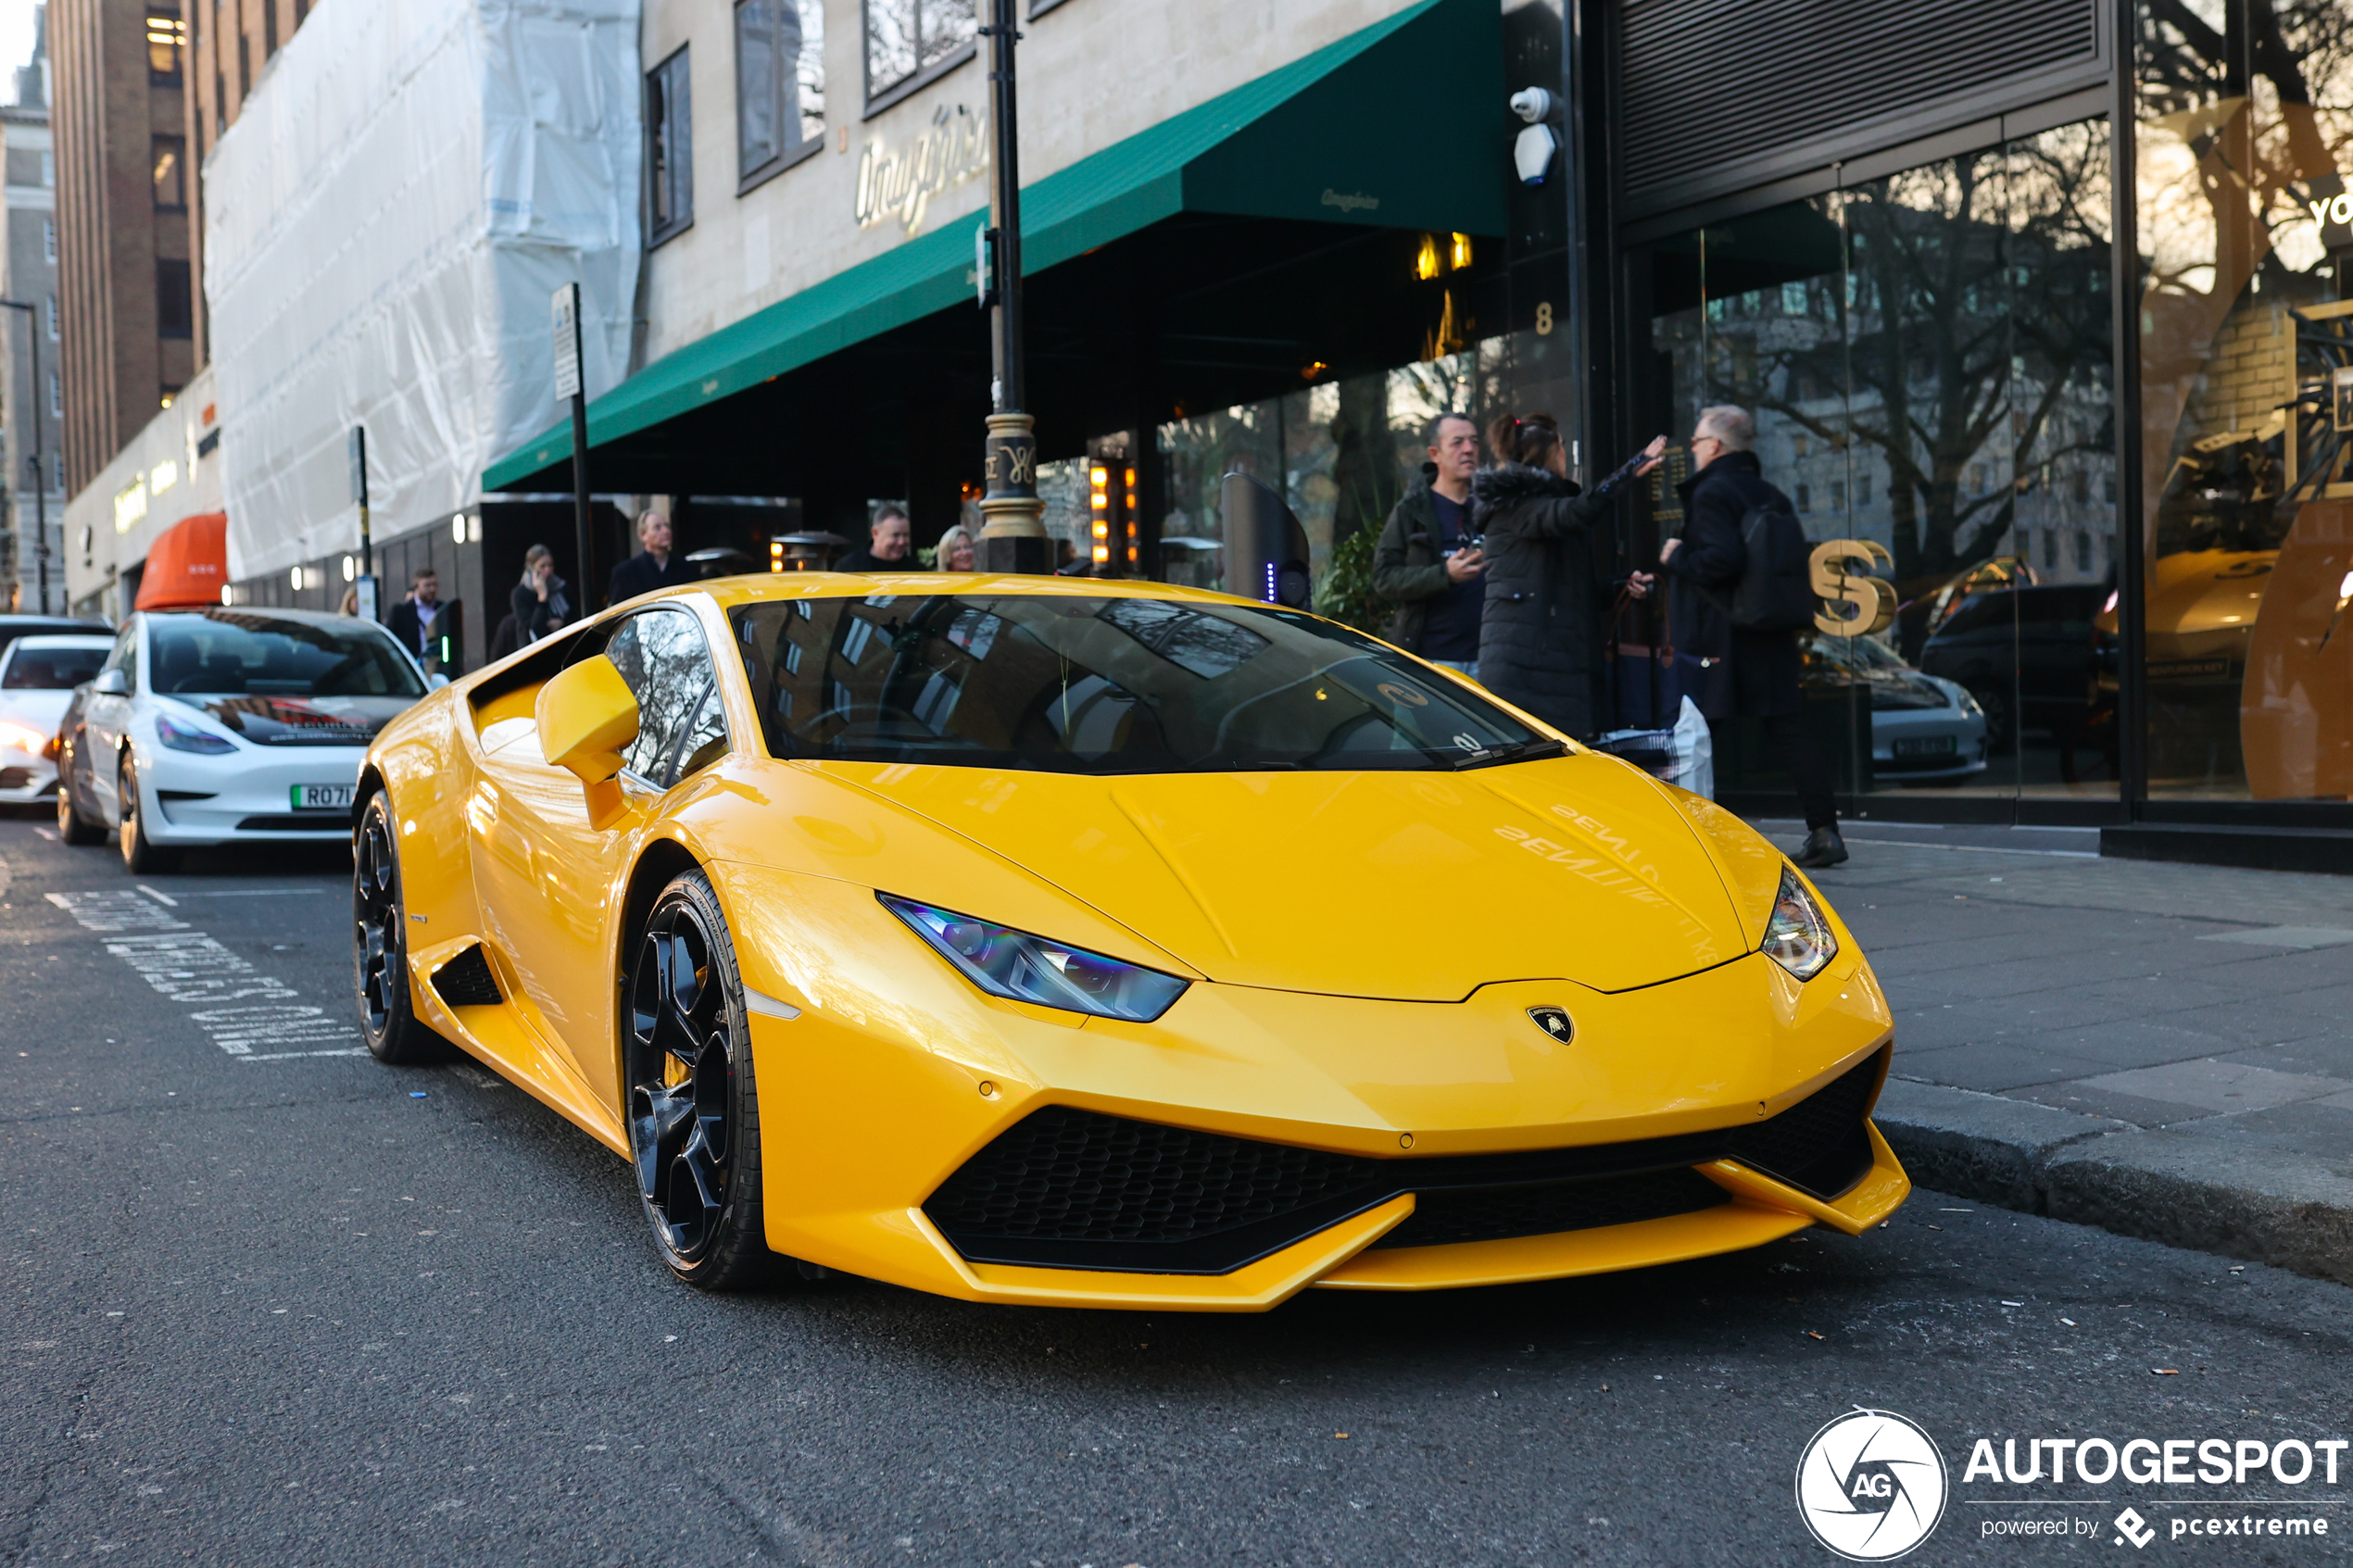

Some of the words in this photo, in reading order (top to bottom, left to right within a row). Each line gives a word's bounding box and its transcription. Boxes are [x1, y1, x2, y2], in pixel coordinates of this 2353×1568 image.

[1536, 302, 1553, 335] 8
[308, 788, 350, 805] RO71
[190, 1004, 372, 1061] ONLY
